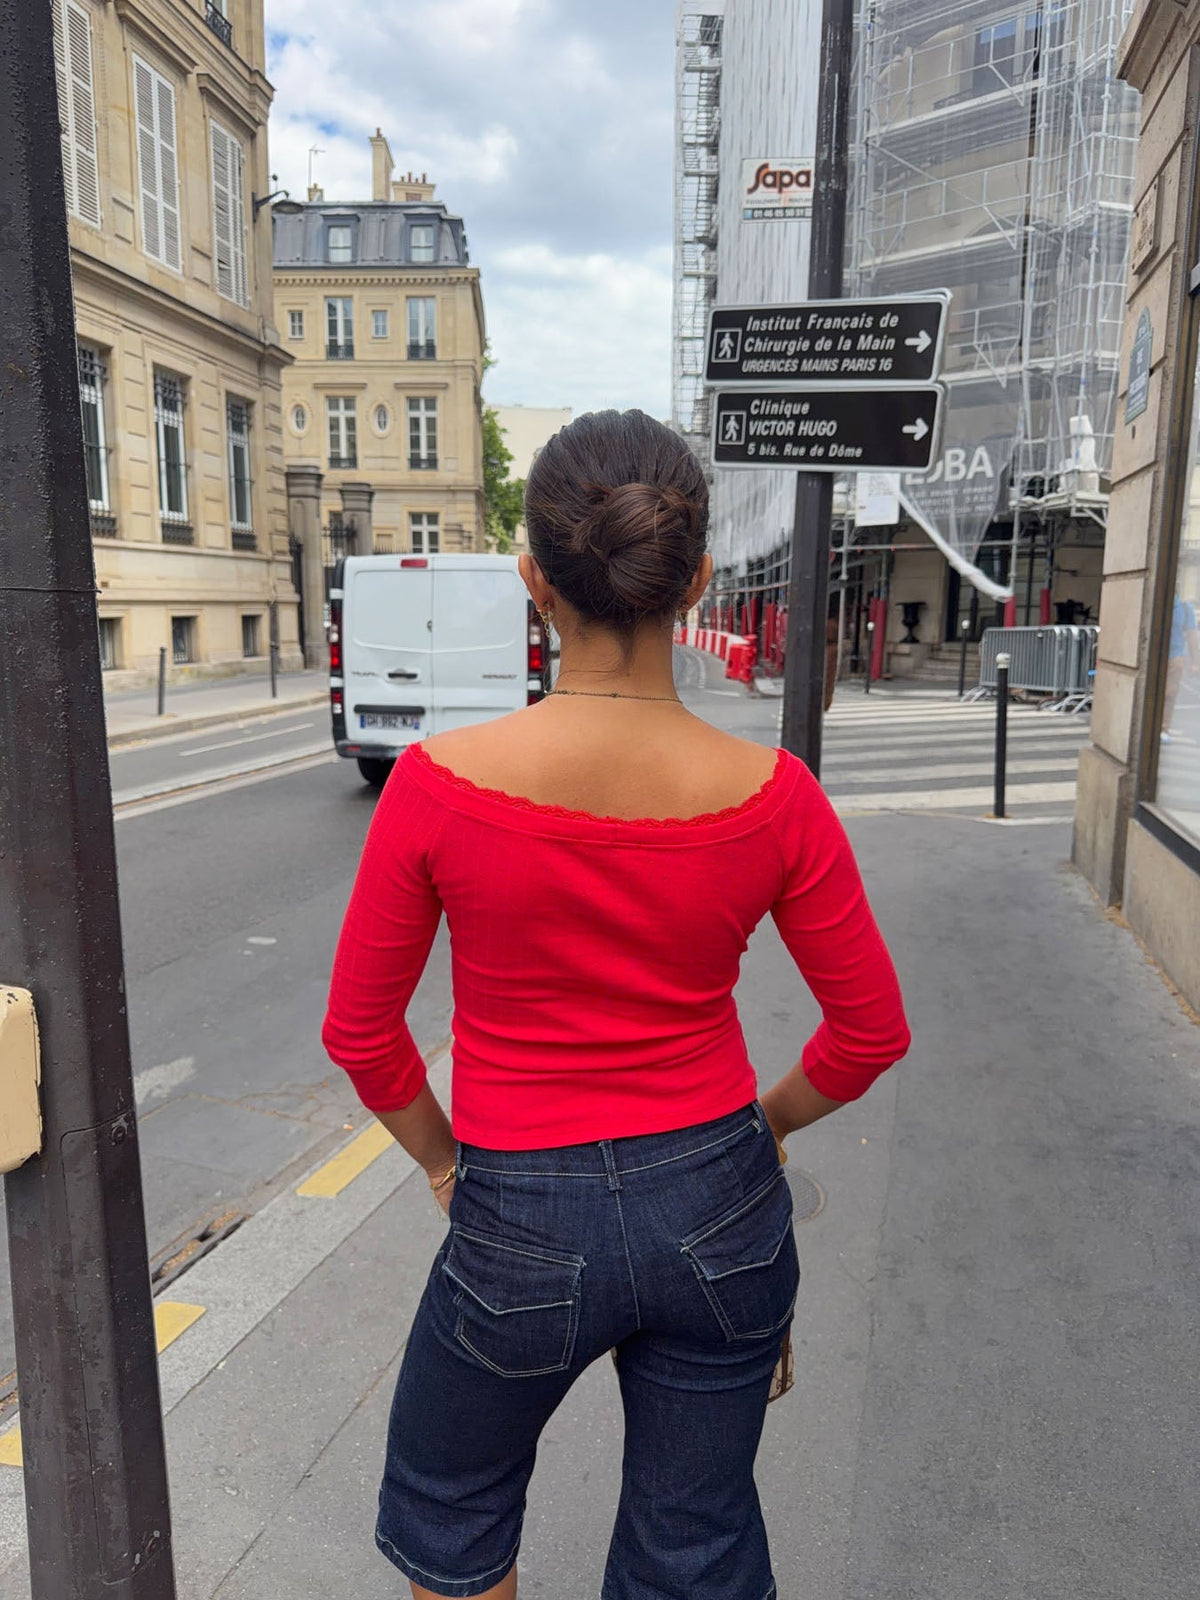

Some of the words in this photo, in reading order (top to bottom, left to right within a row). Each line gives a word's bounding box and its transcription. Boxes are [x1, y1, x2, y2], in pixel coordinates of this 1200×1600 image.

[747, 163, 812, 195] Sapa
[747, 316, 801, 331] Institut
[807, 314, 873, 331] Français
[879, 312, 899, 327] de
[744, 337, 809, 356] Chirurgie
[814, 337, 832, 351] de
[837, 336, 852, 351] la
[856, 335, 895, 350] Main
[742, 358, 798, 373] URGENCES
[801, 358, 838, 372] MAINS
[840, 358, 876, 372] PARIS
[879, 358, 893, 371] 16
[750, 399, 810, 418] Clinique
[749, 421, 794, 436] VICTOR
[797, 421, 837, 436] HUGO
[747, 443, 756, 456] 5
[759, 443, 780, 455] bis.
[783, 443, 805, 456] Rue
[809, 444, 824, 457] de
[828, 443, 863, 457] Dôme
